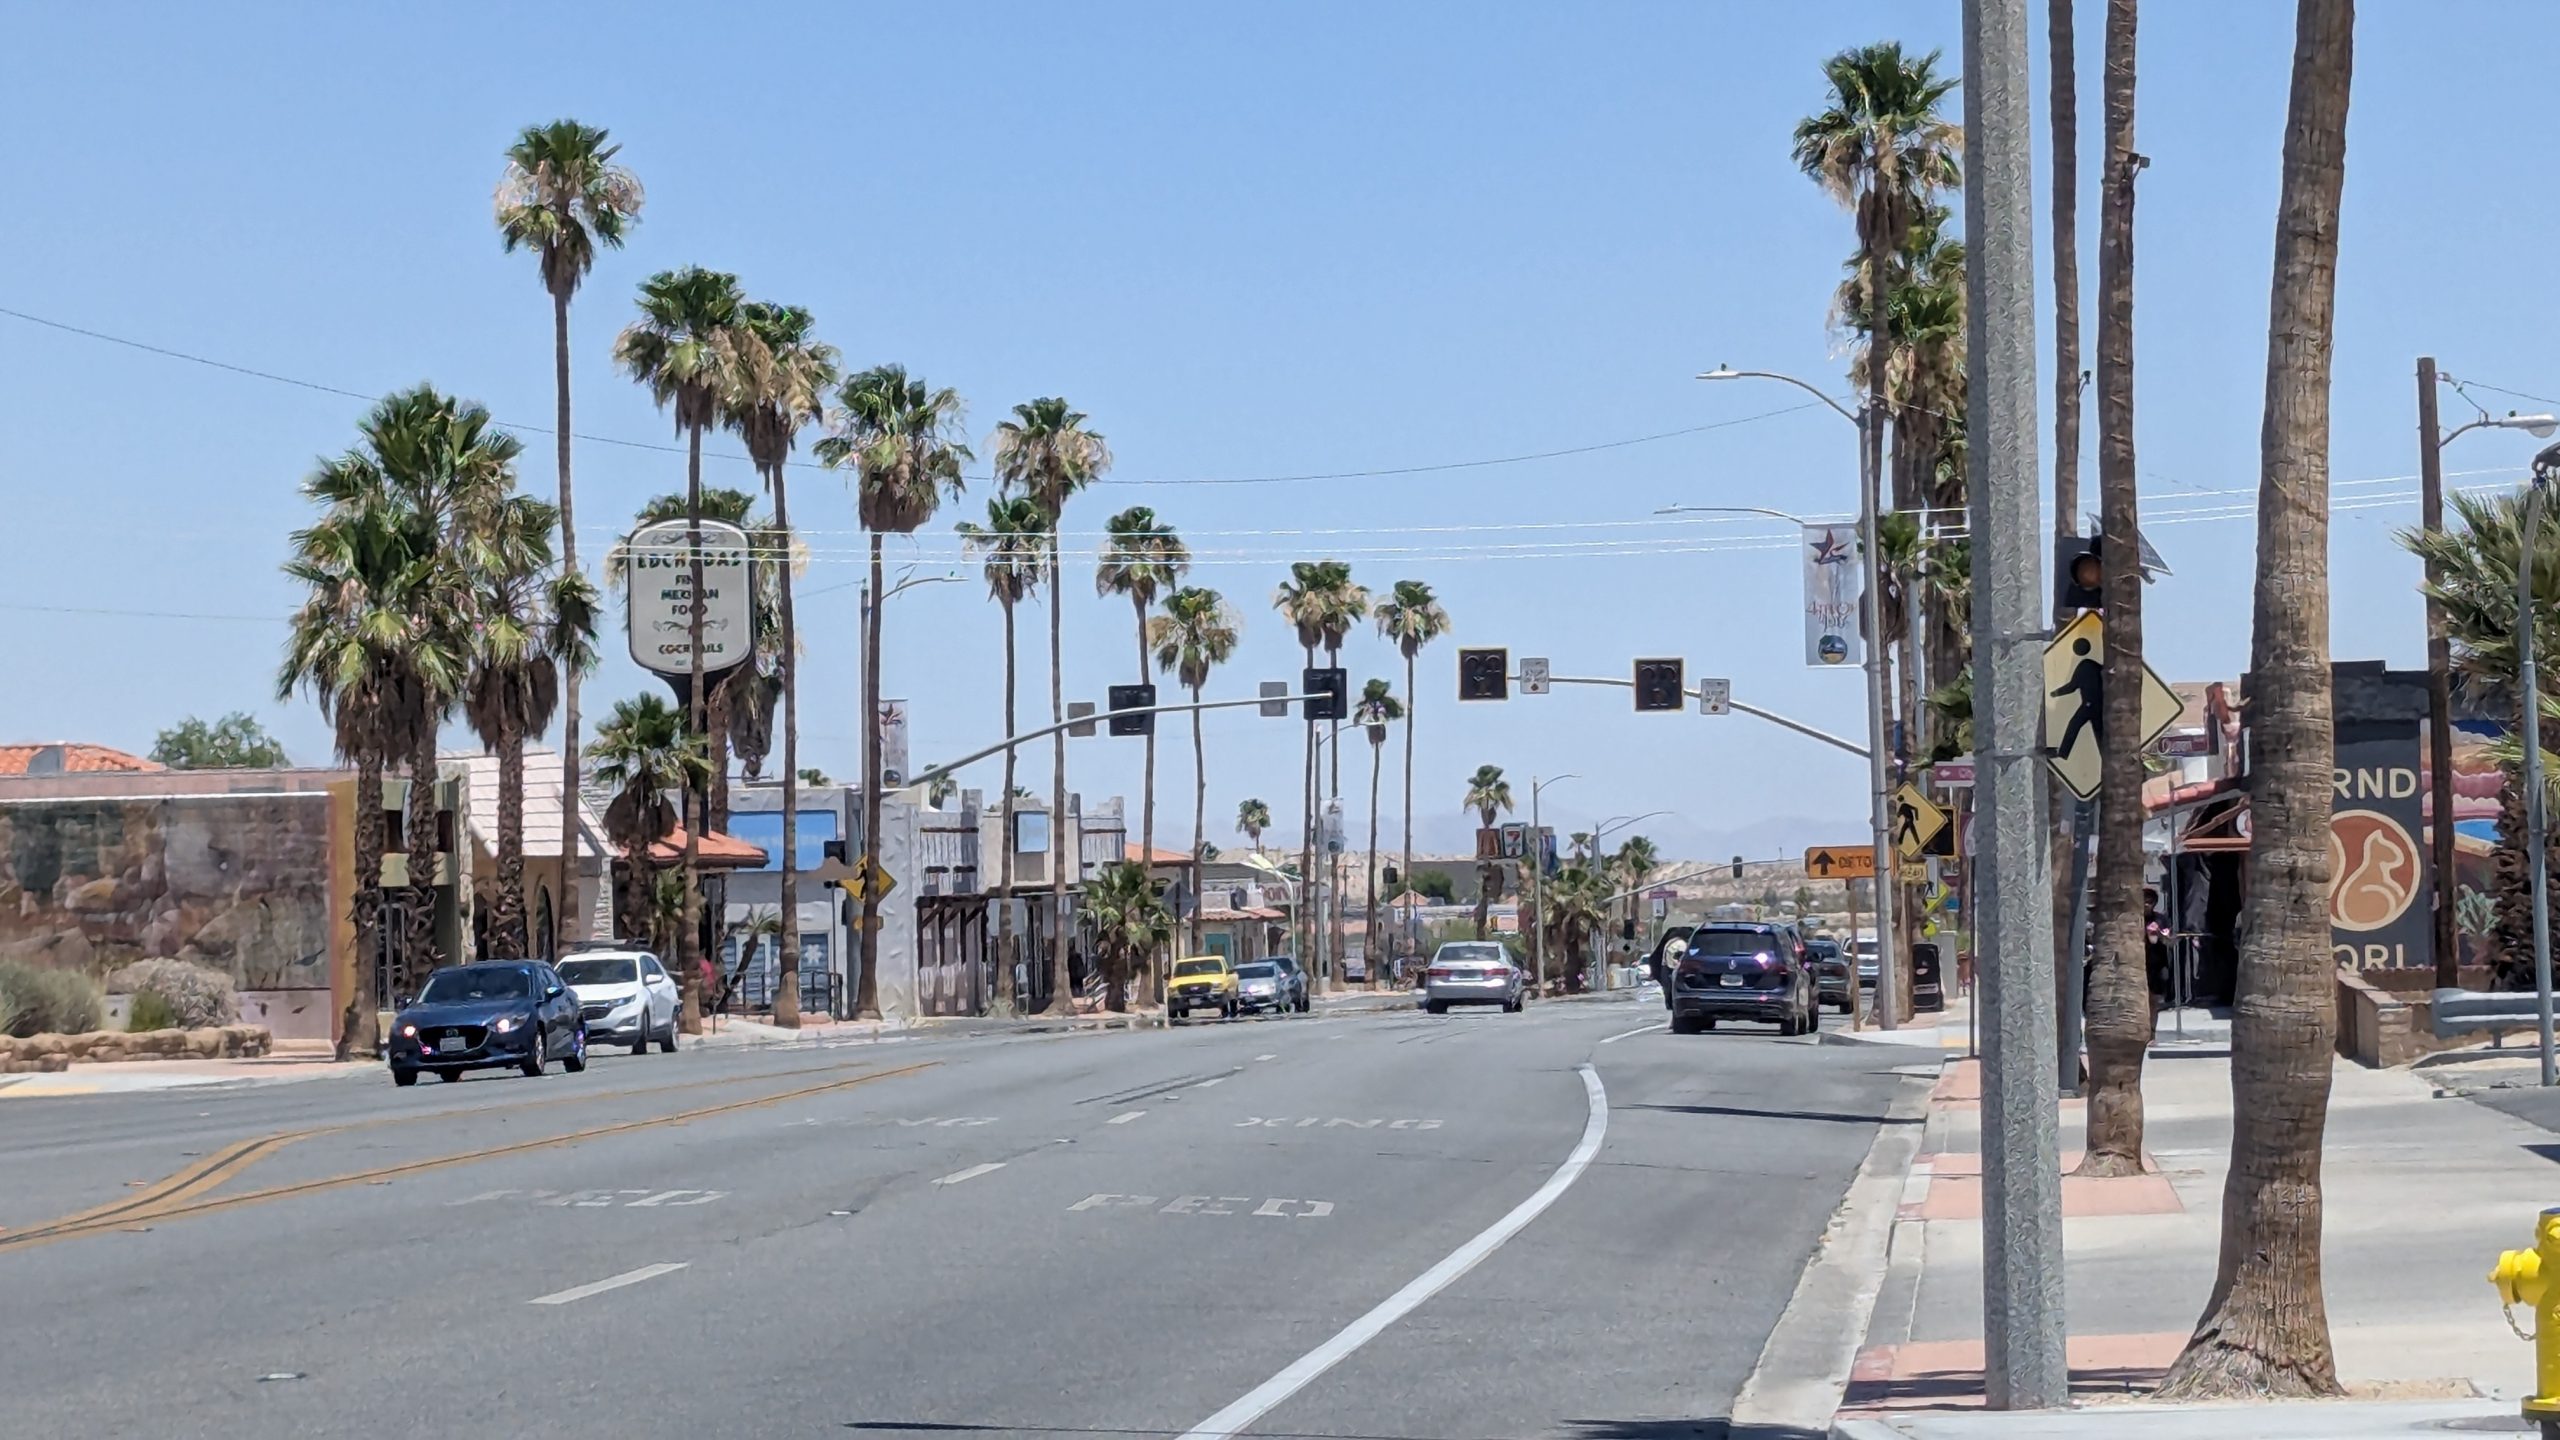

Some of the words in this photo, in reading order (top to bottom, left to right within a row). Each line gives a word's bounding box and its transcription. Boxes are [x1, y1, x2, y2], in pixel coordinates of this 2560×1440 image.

[638, 551, 741, 569] EDCHDAS
[675, 574, 693, 585] FIN
[658, 643, 724, 655] COCKAILS
[2333, 768, 2417, 799] RND
[1838, 855, 1873, 869] DETO
[1234, 1116, 1445, 1129] XING
[1065, 1193, 1336, 1218] PED
